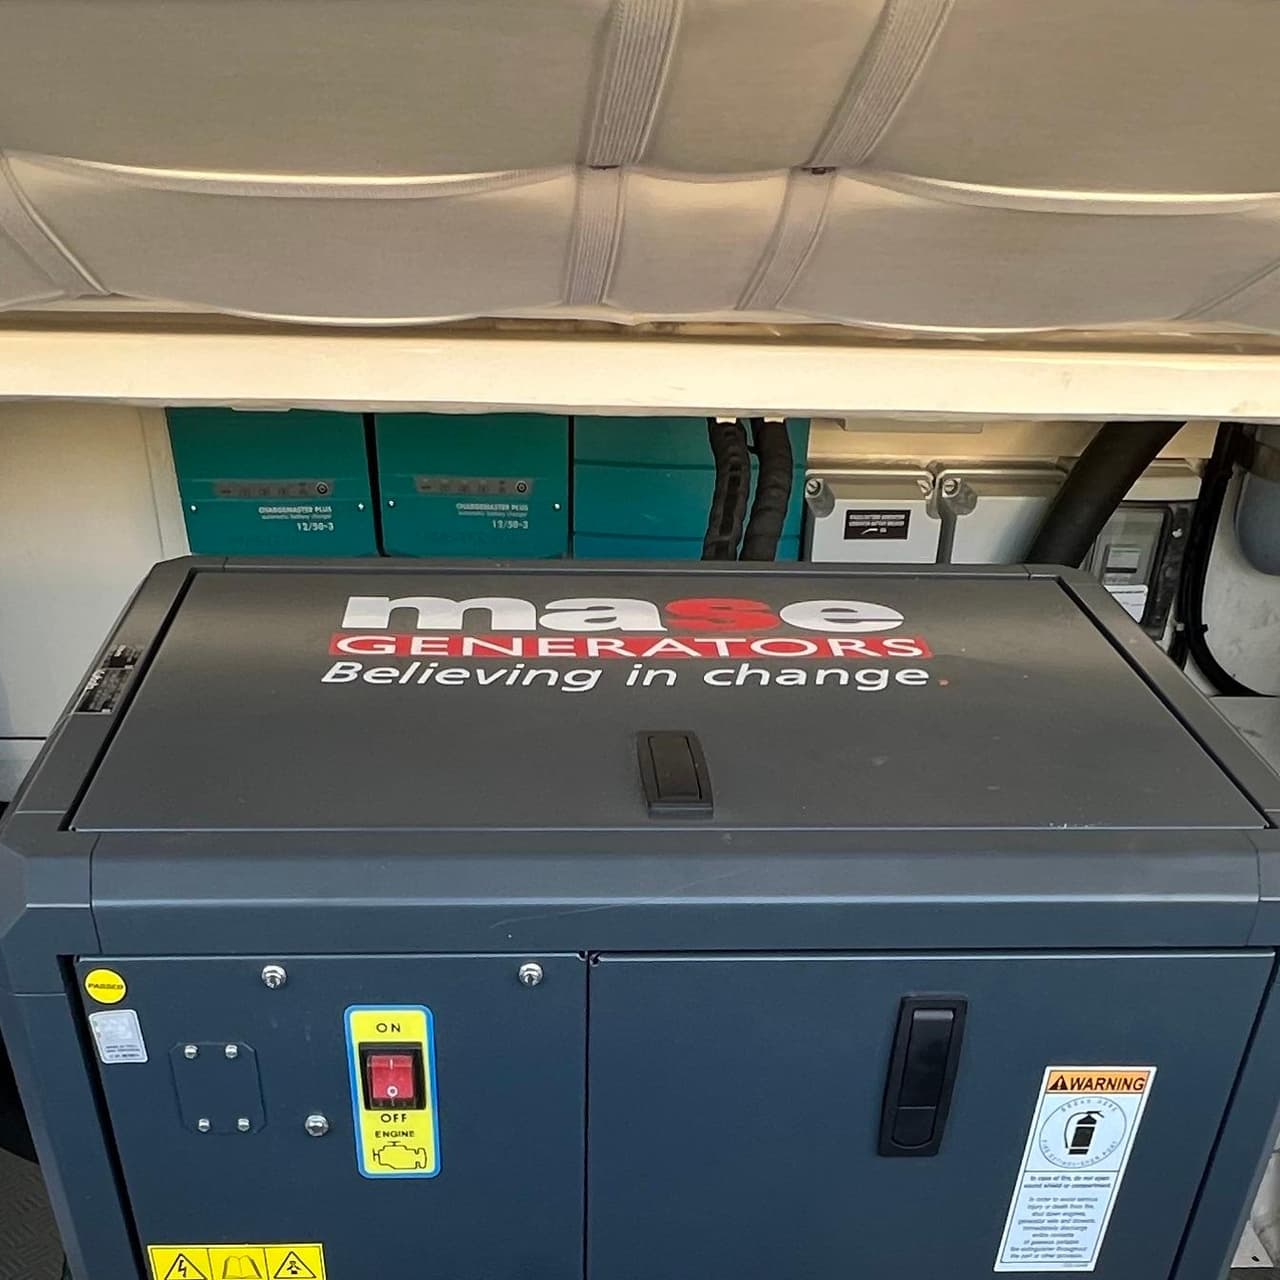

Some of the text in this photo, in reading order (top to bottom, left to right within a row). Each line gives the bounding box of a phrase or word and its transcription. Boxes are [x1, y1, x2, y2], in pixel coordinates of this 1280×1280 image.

[342, 596, 904, 632] mase
[336, 634, 924, 657] GENERATORS
[321, 661, 603, 692] Believing
[625, 663, 678, 686] in
[376, 1023, 401, 1033] ON
[1070, 1077, 1145, 1091] WARNING
[380, 1113, 407, 1123] OFF
[375, 1130, 415, 1138] ENGINE
